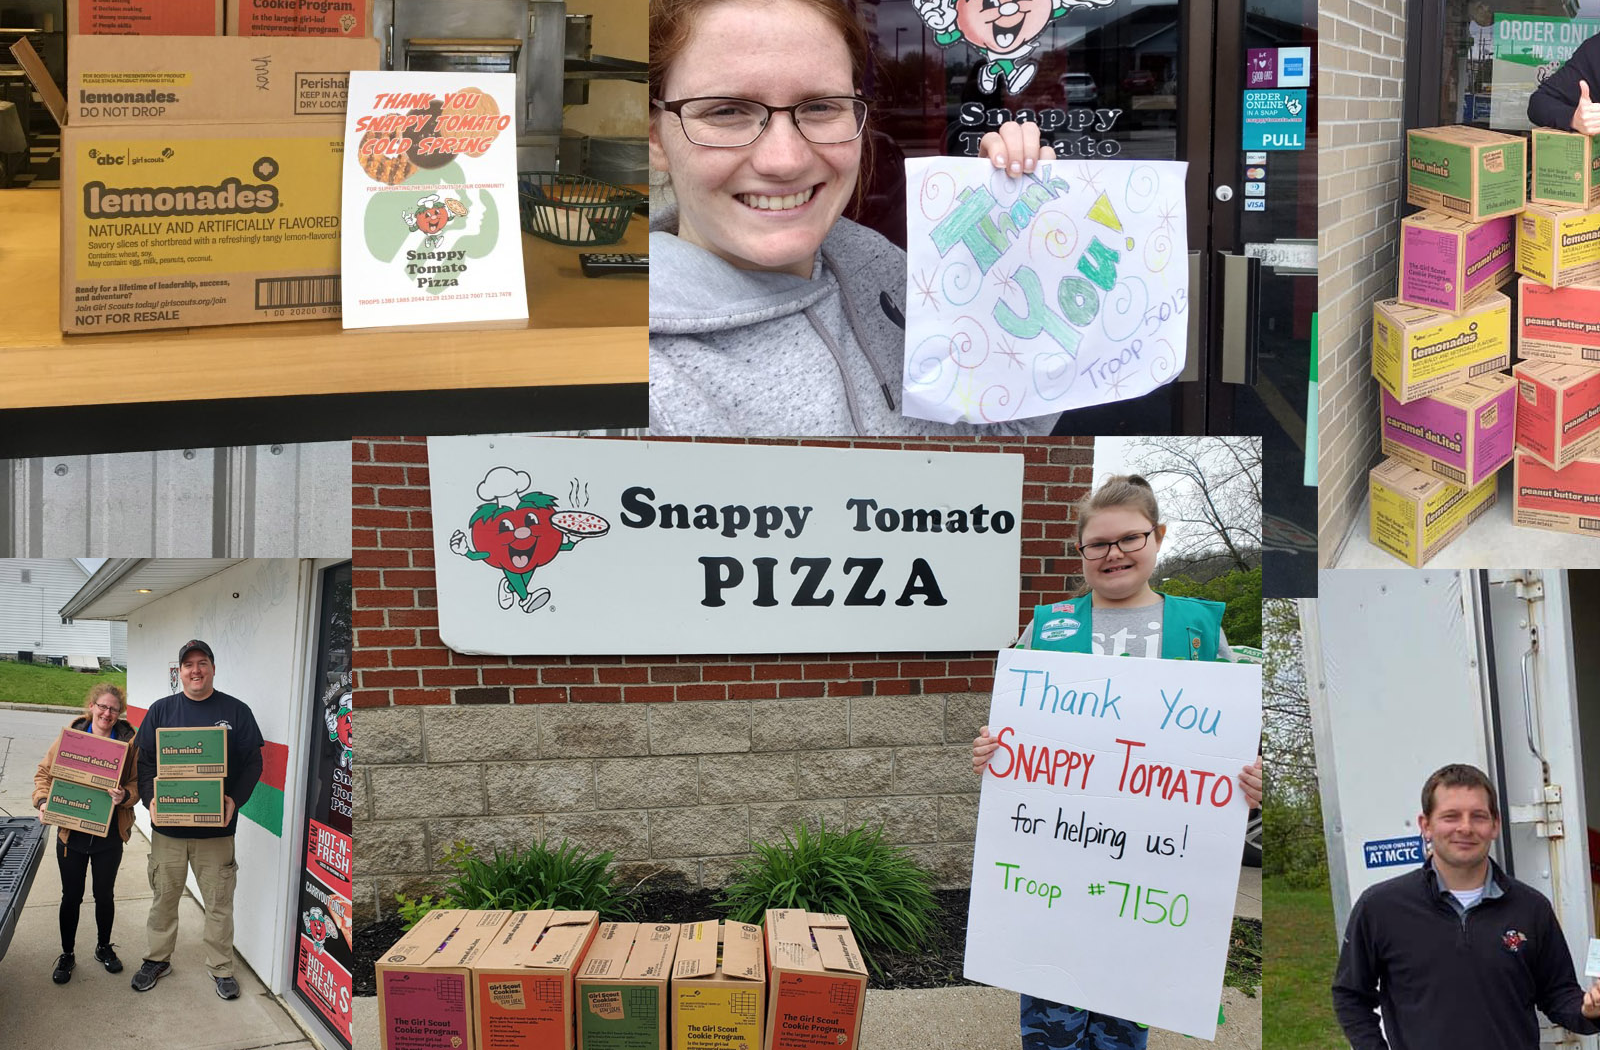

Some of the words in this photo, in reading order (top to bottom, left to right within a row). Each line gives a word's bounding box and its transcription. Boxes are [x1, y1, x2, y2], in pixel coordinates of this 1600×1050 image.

[373, 93, 435, 109] THANK
[441, 93, 480, 109] YOU
[356, 115, 432, 132] SNAPPY
[434, 114, 510, 132] TOMATO
[960, 102, 1123, 132] Snappy
[362, 136, 413, 155] COLD
[417, 137, 491, 155] SPRING
[1262, 134, 1302, 147] PULL
[89, 183, 274, 213] lemonades
[88, 220, 162, 237] NATURALLY
[166, 220, 195, 233] AND
[198, 218, 274, 232] ARTIFICIALLY
[279, 216, 338, 230] FLAVORED
[930, 162, 1071, 276] Thank
[406, 248, 467, 265] Snappy
[406, 261, 467, 276] Tomato
[417, 276, 459, 290] Pizza
[1079, 338, 1145, 388] Troop
[1144, 290, 1188, 335] 5013
[621, 486, 813, 539] Snappy
[845, 497, 1014, 535] Tomato
[698, 557, 948, 608] PIZZA
[1009, 668, 1121, 720] Thank
[1160, 687, 1220, 738] You
[988, 726, 1095, 791] SNAPPY
[1115, 738, 1233, 807] TOMATO
[1011, 804, 1047, 835] for
[1054, 808, 1126, 859] helping
[1146, 823, 1189, 857] us!
[1370, 852, 1383, 864] AT
[1385, 848, 1419, 862] MCTC
[995, 861, 1063, 909] Troop
[1087, 880, 1189, 927] #7150
